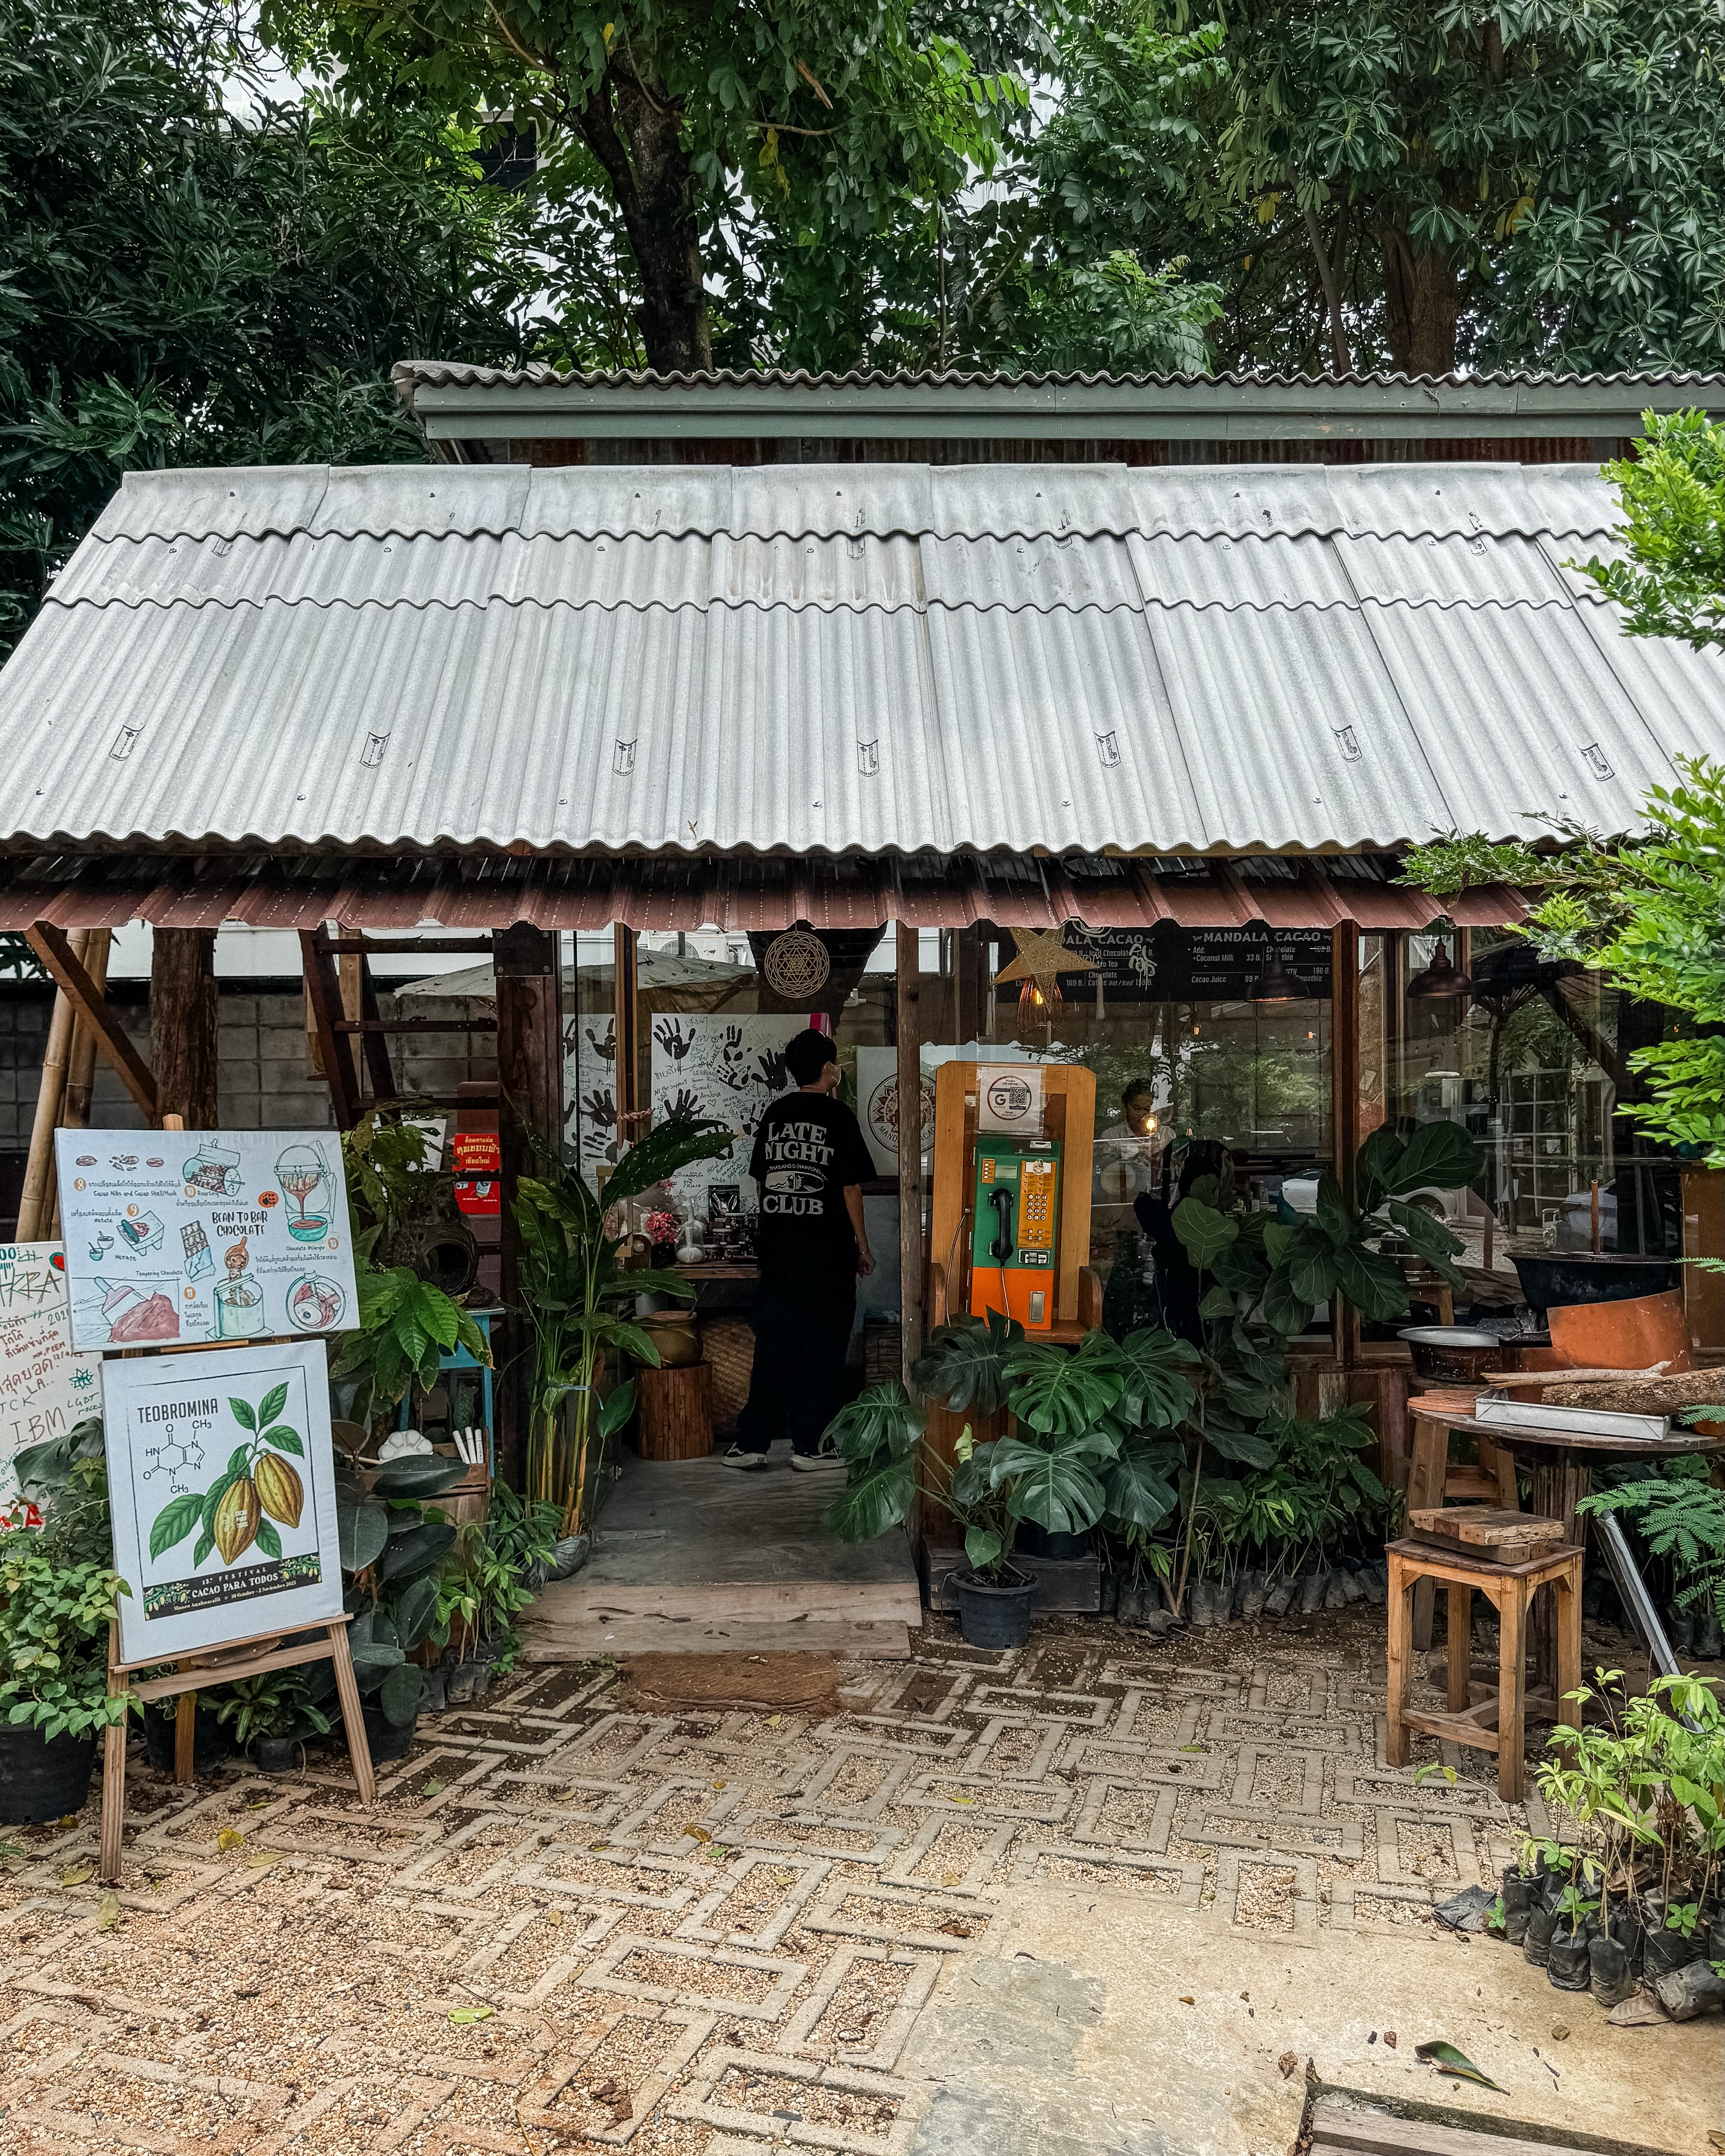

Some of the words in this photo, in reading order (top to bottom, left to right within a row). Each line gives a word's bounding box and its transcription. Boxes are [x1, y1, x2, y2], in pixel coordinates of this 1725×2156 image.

[1098, 934, 1143, 944] CACAO
[1203, 932, 1269, 942] MANDALA
[1275, 932, 1321, 942] CACAO
[767, 1122, 827, 1145] LATE
[878, 1125, 899, 1143] MAND
[764, 1141, 834, 1166] NIGHT
[130, 1204, 137, 1216] 9
[763, 1194, 824, 1215] CLUB
[212, 1212, 234, 1224] BEAN
[236, 1212, 249, 1224] TO
[251, 1211, 268, 1223] BAR
[216, 1224, 265, 1237] CHOCOLATE
[67, 1392, 99, 1408] LGBT
[137, 1398, 218, 1424] TEOBROMINA
[9, 1406, 66, 1445] IBM
[165, 1423, 174, 1433] O
[145, 1447, 161, 1457] HN
[191, 1440, 198, 1449] N
[143, 1471, 152, 1480] O
[169, 1467, 176, 1476] N
[194, 1462, 201, 1470] N
[218, 1566, 267, 1582] FESTIVAL
[192, 1585, 221, 1598] CACAO
[223, 1580, 247, 1592] PARA
[248, 1572, 278, 1586] TODOS
